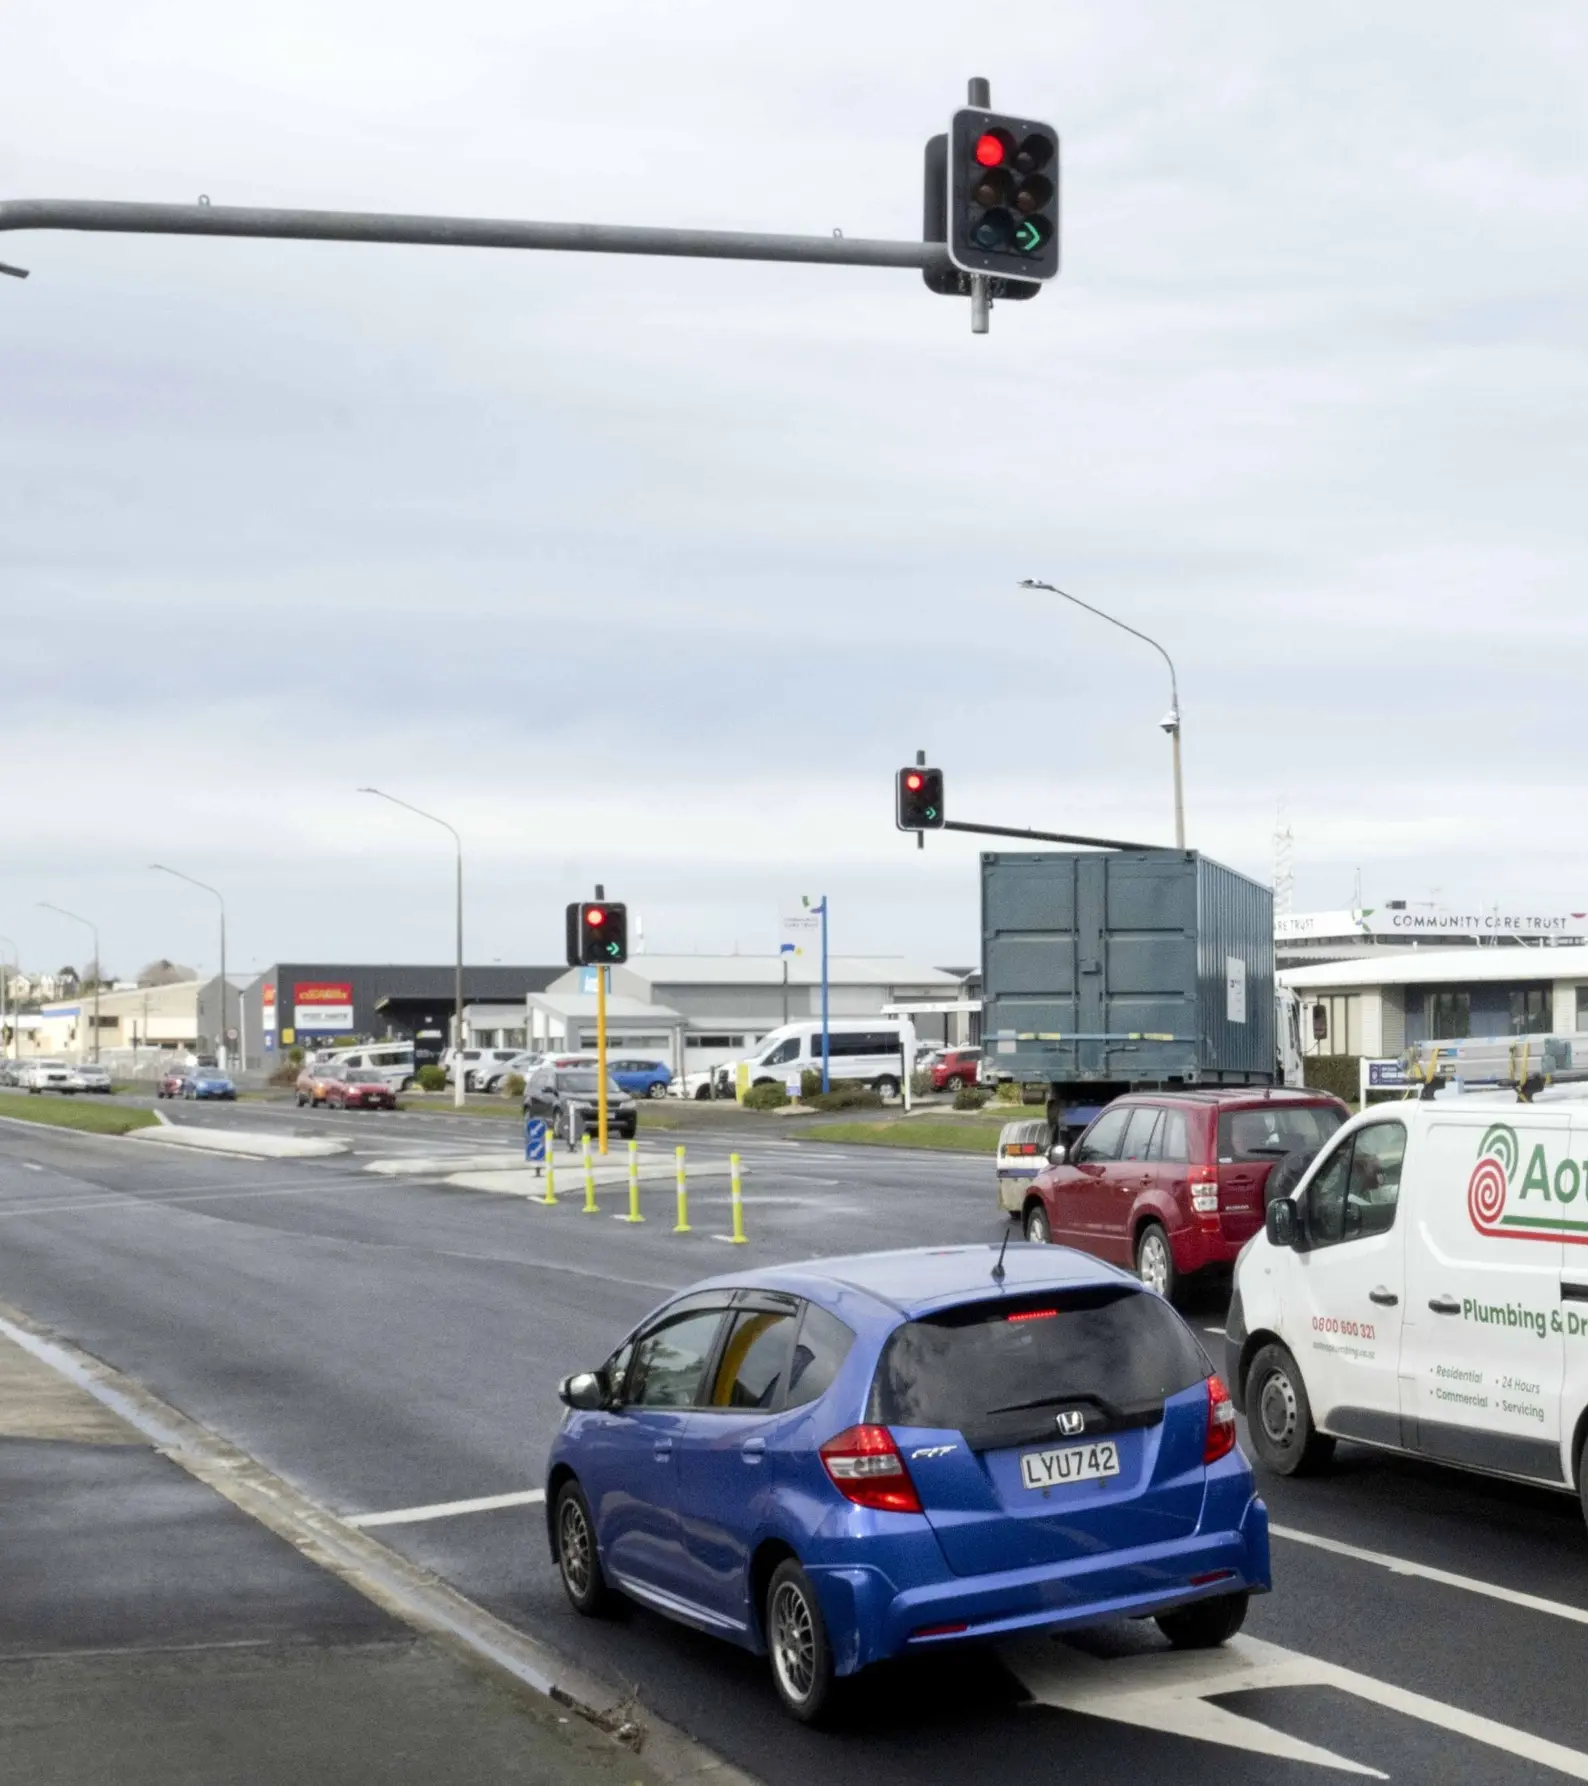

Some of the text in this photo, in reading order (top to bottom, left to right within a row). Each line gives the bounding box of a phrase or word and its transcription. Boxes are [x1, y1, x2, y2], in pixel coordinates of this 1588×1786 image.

[1274, 918, 1314, 932] RE TRUST
[1393, 915, 1567, 930] COMMUNITY CARE TRUST
[1312, 1316, 1376, 1340] 0800 600 321
[1463, 1299, 1546, 1339] Plumbing
[1550, 1309, 1564, 1333] &
[1436, 1364, 1483, 1384] Residential
[1501, 1375, 1541, 1395] 24 Hours
[1436, 1387, 1489, 1408] Commercial
[1501, 1399, 1545, 1423] Servicing
[1026, 1446, 1116, 1484] LYU742
